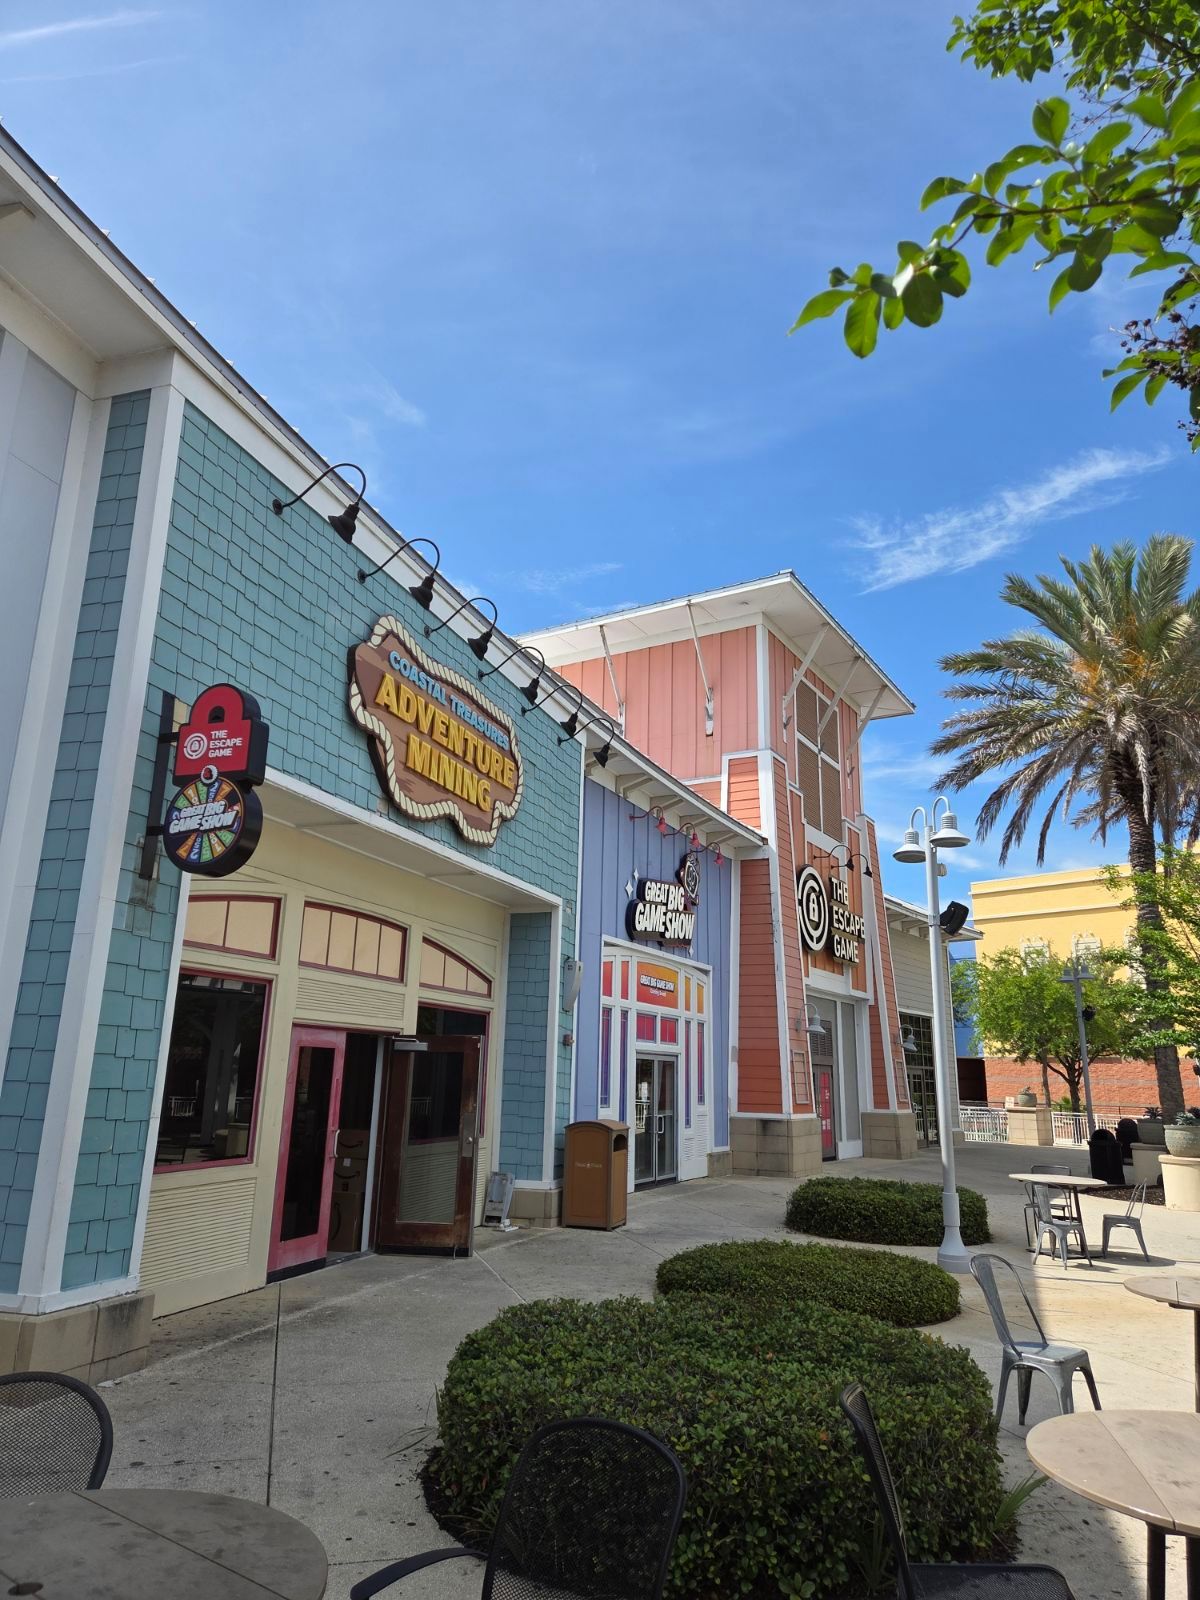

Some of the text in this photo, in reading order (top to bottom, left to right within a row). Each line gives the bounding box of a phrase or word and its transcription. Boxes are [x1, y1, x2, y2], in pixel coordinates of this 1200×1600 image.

[389, 650, 509, 750] COASTAL TREASURES
[210, 738, 242, 748] ESCAPE
[211, 730, 228, 739] THE
[375, 672, 515, 790] ADVENTURE
[208, 748, 233, 758] GAME
[406, 733, 491, 812] MINING
[169, 810, 238, 834] GAME SHOW
[180, 803, 207, 818] GREAT
[203, 800, 226, 817] BIG
[645, 880, 685, 912] GREAT BIG
[831, 877, 849, 905] THE
[634, 902, 695, 940] GAME SHOW
[833, 905, 865, 939] ESCAPE
[833, 934, 860, 963] GAME
